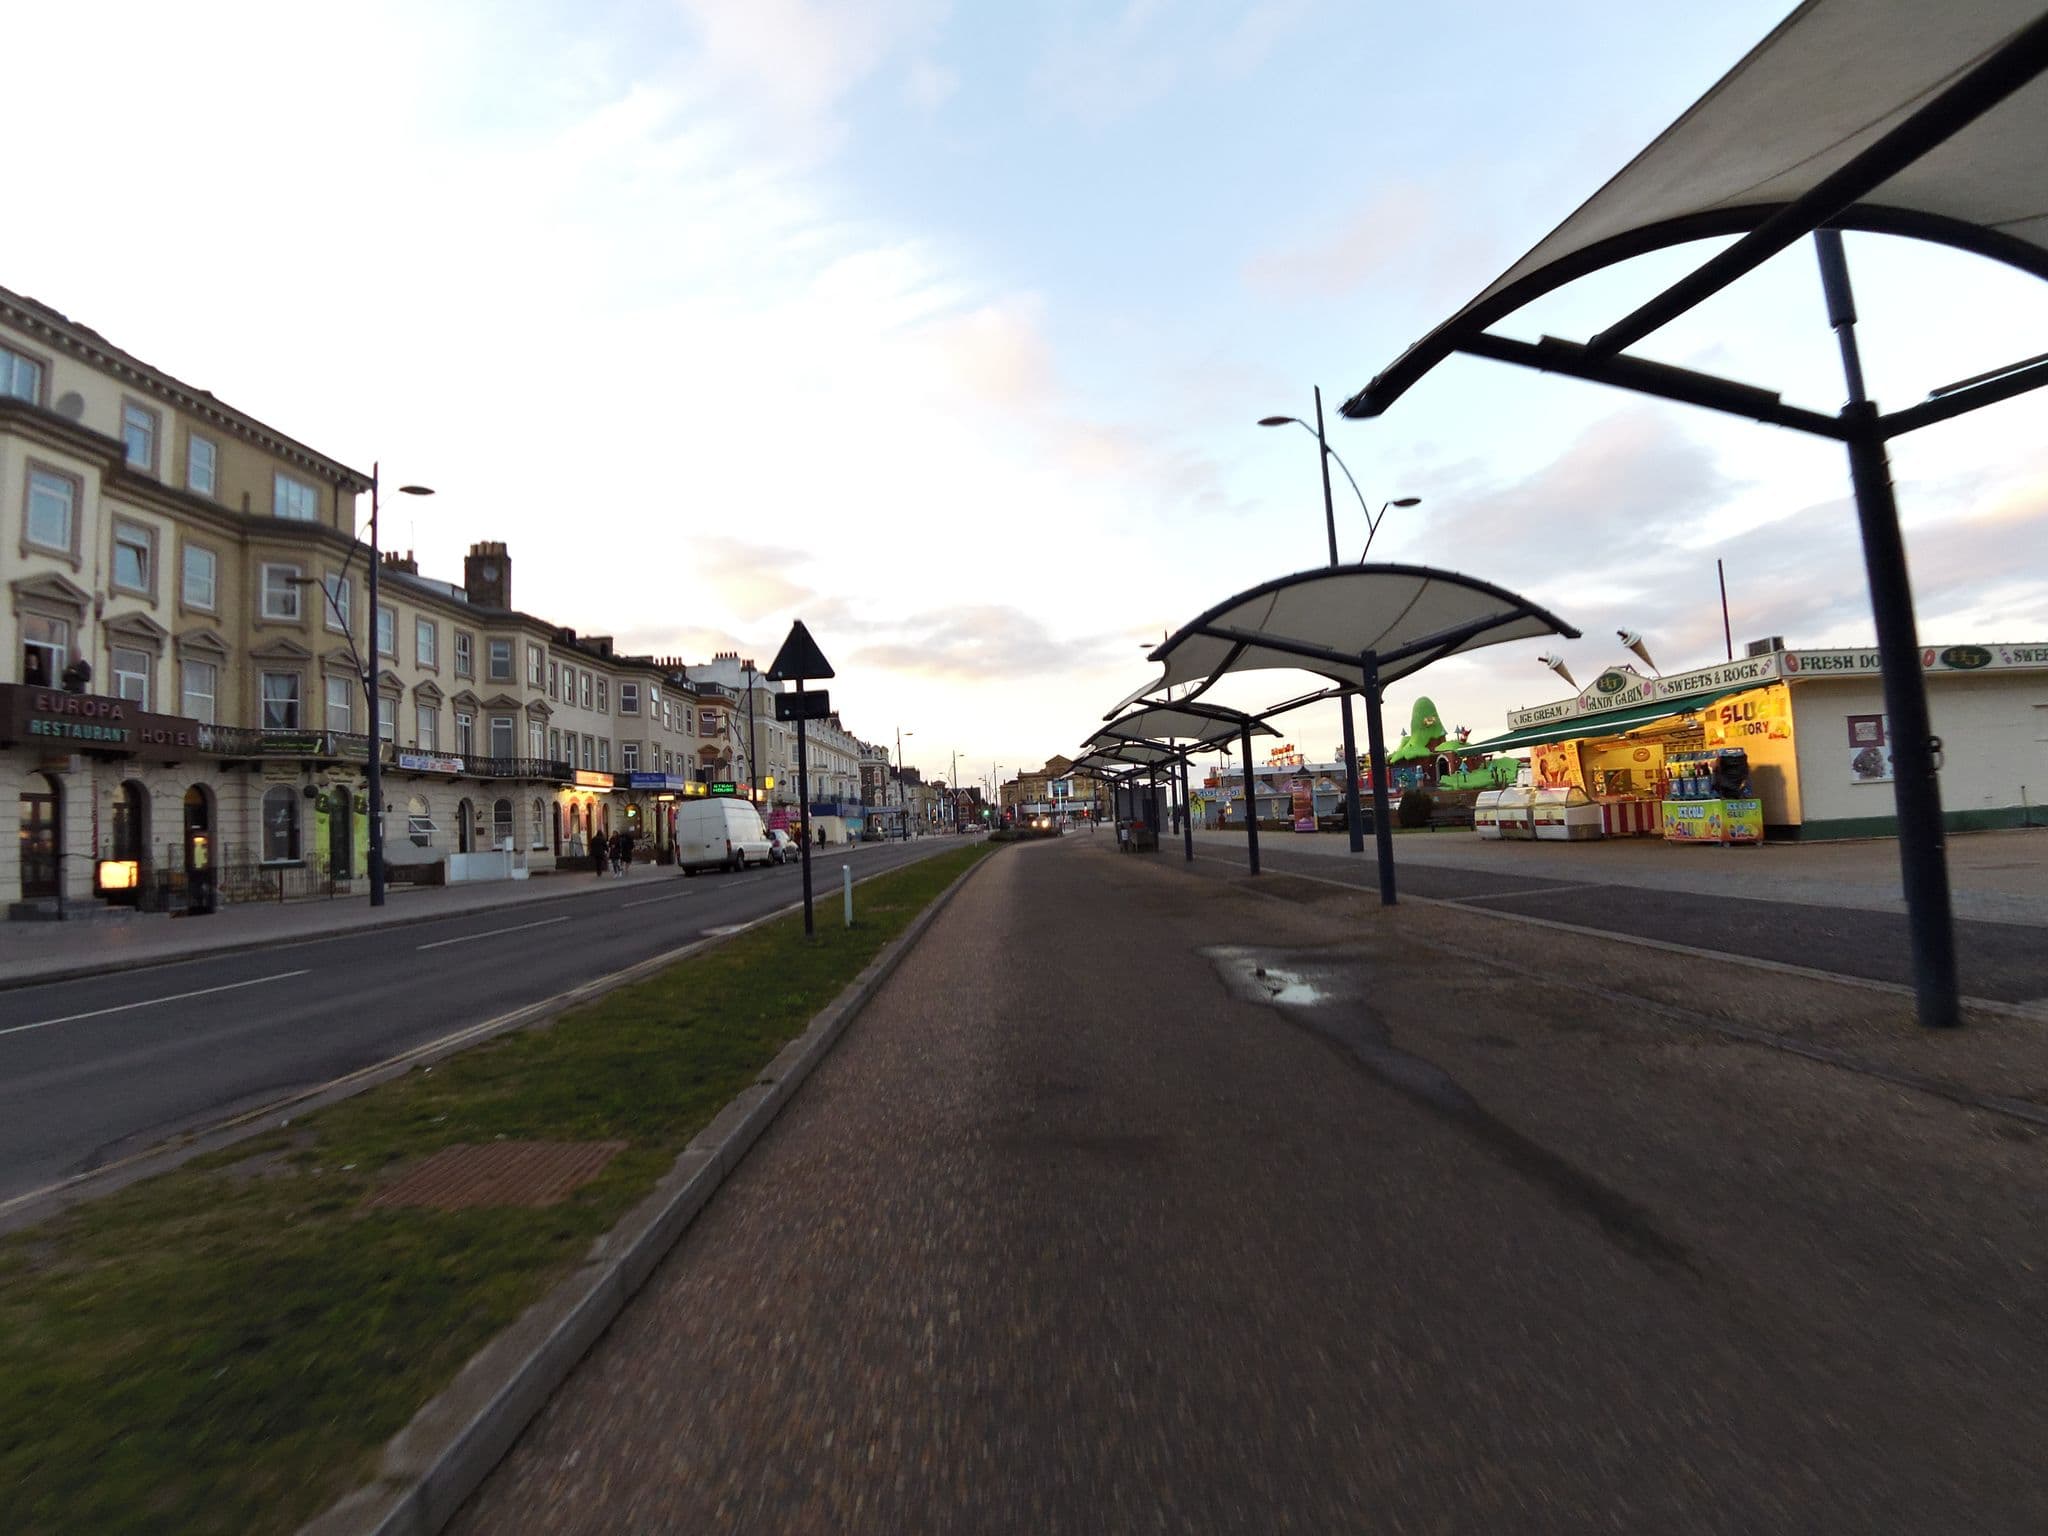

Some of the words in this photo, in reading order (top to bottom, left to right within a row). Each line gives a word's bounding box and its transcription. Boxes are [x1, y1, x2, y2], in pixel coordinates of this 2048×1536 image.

[1799, 654, 1855, 671] FRESH
[1667, 672, 1713, 694] SWEETS
[1714, 671, 1721, 685] &
[1723, 662, 1759, 683] ROCK
[36, 694, 125, 720] EUROPA
[1585, 694, 1615, 711] CANDY
[1615, 683, 1643, 706] CABIN
[1519, 712, 1533, 724] ICE
[1533, 706, 1562, 721] CREAM
[30, 719, 130, 743] RESTAURANT
[141, 727, 196, 747] HOTEL
[1723, 720, 1770, 739] FACTORY
[1677, 806, 1689, 819] ICE
[1689, 805, 1705, 819] COLD
